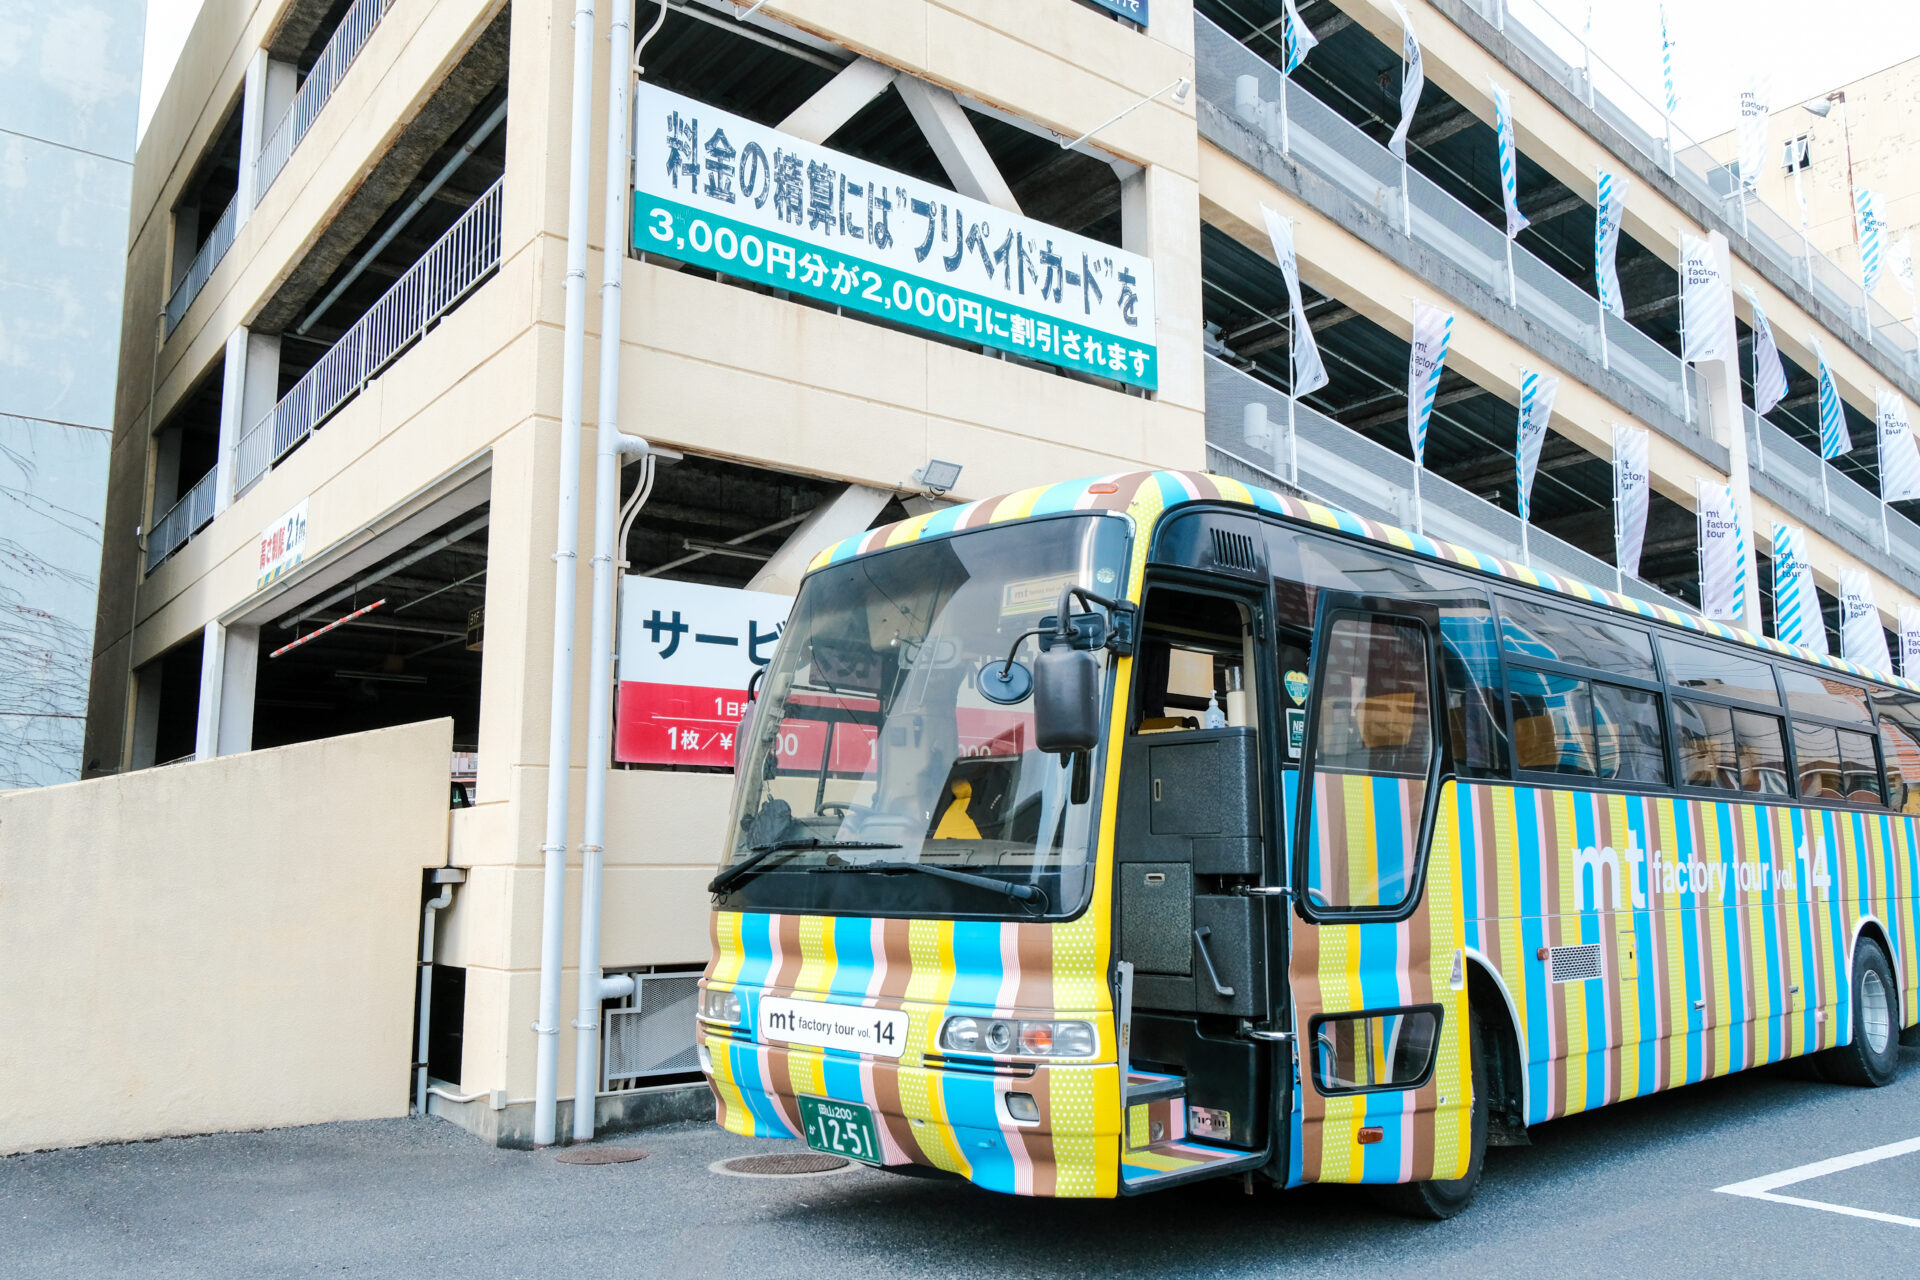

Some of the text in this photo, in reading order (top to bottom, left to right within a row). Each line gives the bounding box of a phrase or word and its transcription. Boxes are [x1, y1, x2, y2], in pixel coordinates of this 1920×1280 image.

[648, 207, 1150, 378] 3,000円分が2,000円に割引されます
[1706, 510, 1720, 518] mt
[1707, 520, 1738, 531] factory
[1707, 529, 1725, 538] tour
[1782, 560, 1810, 571] factor
[1782, 570, 1801, 578] tour
[1850, 610, 1867, 619] tour
[1572, 829, 1831, 911] mt factory tour vol. 14
[769, 1010, 895, 1045] mt factory tour vol. 14
[818, 1117, 873, 1158] 12-51
